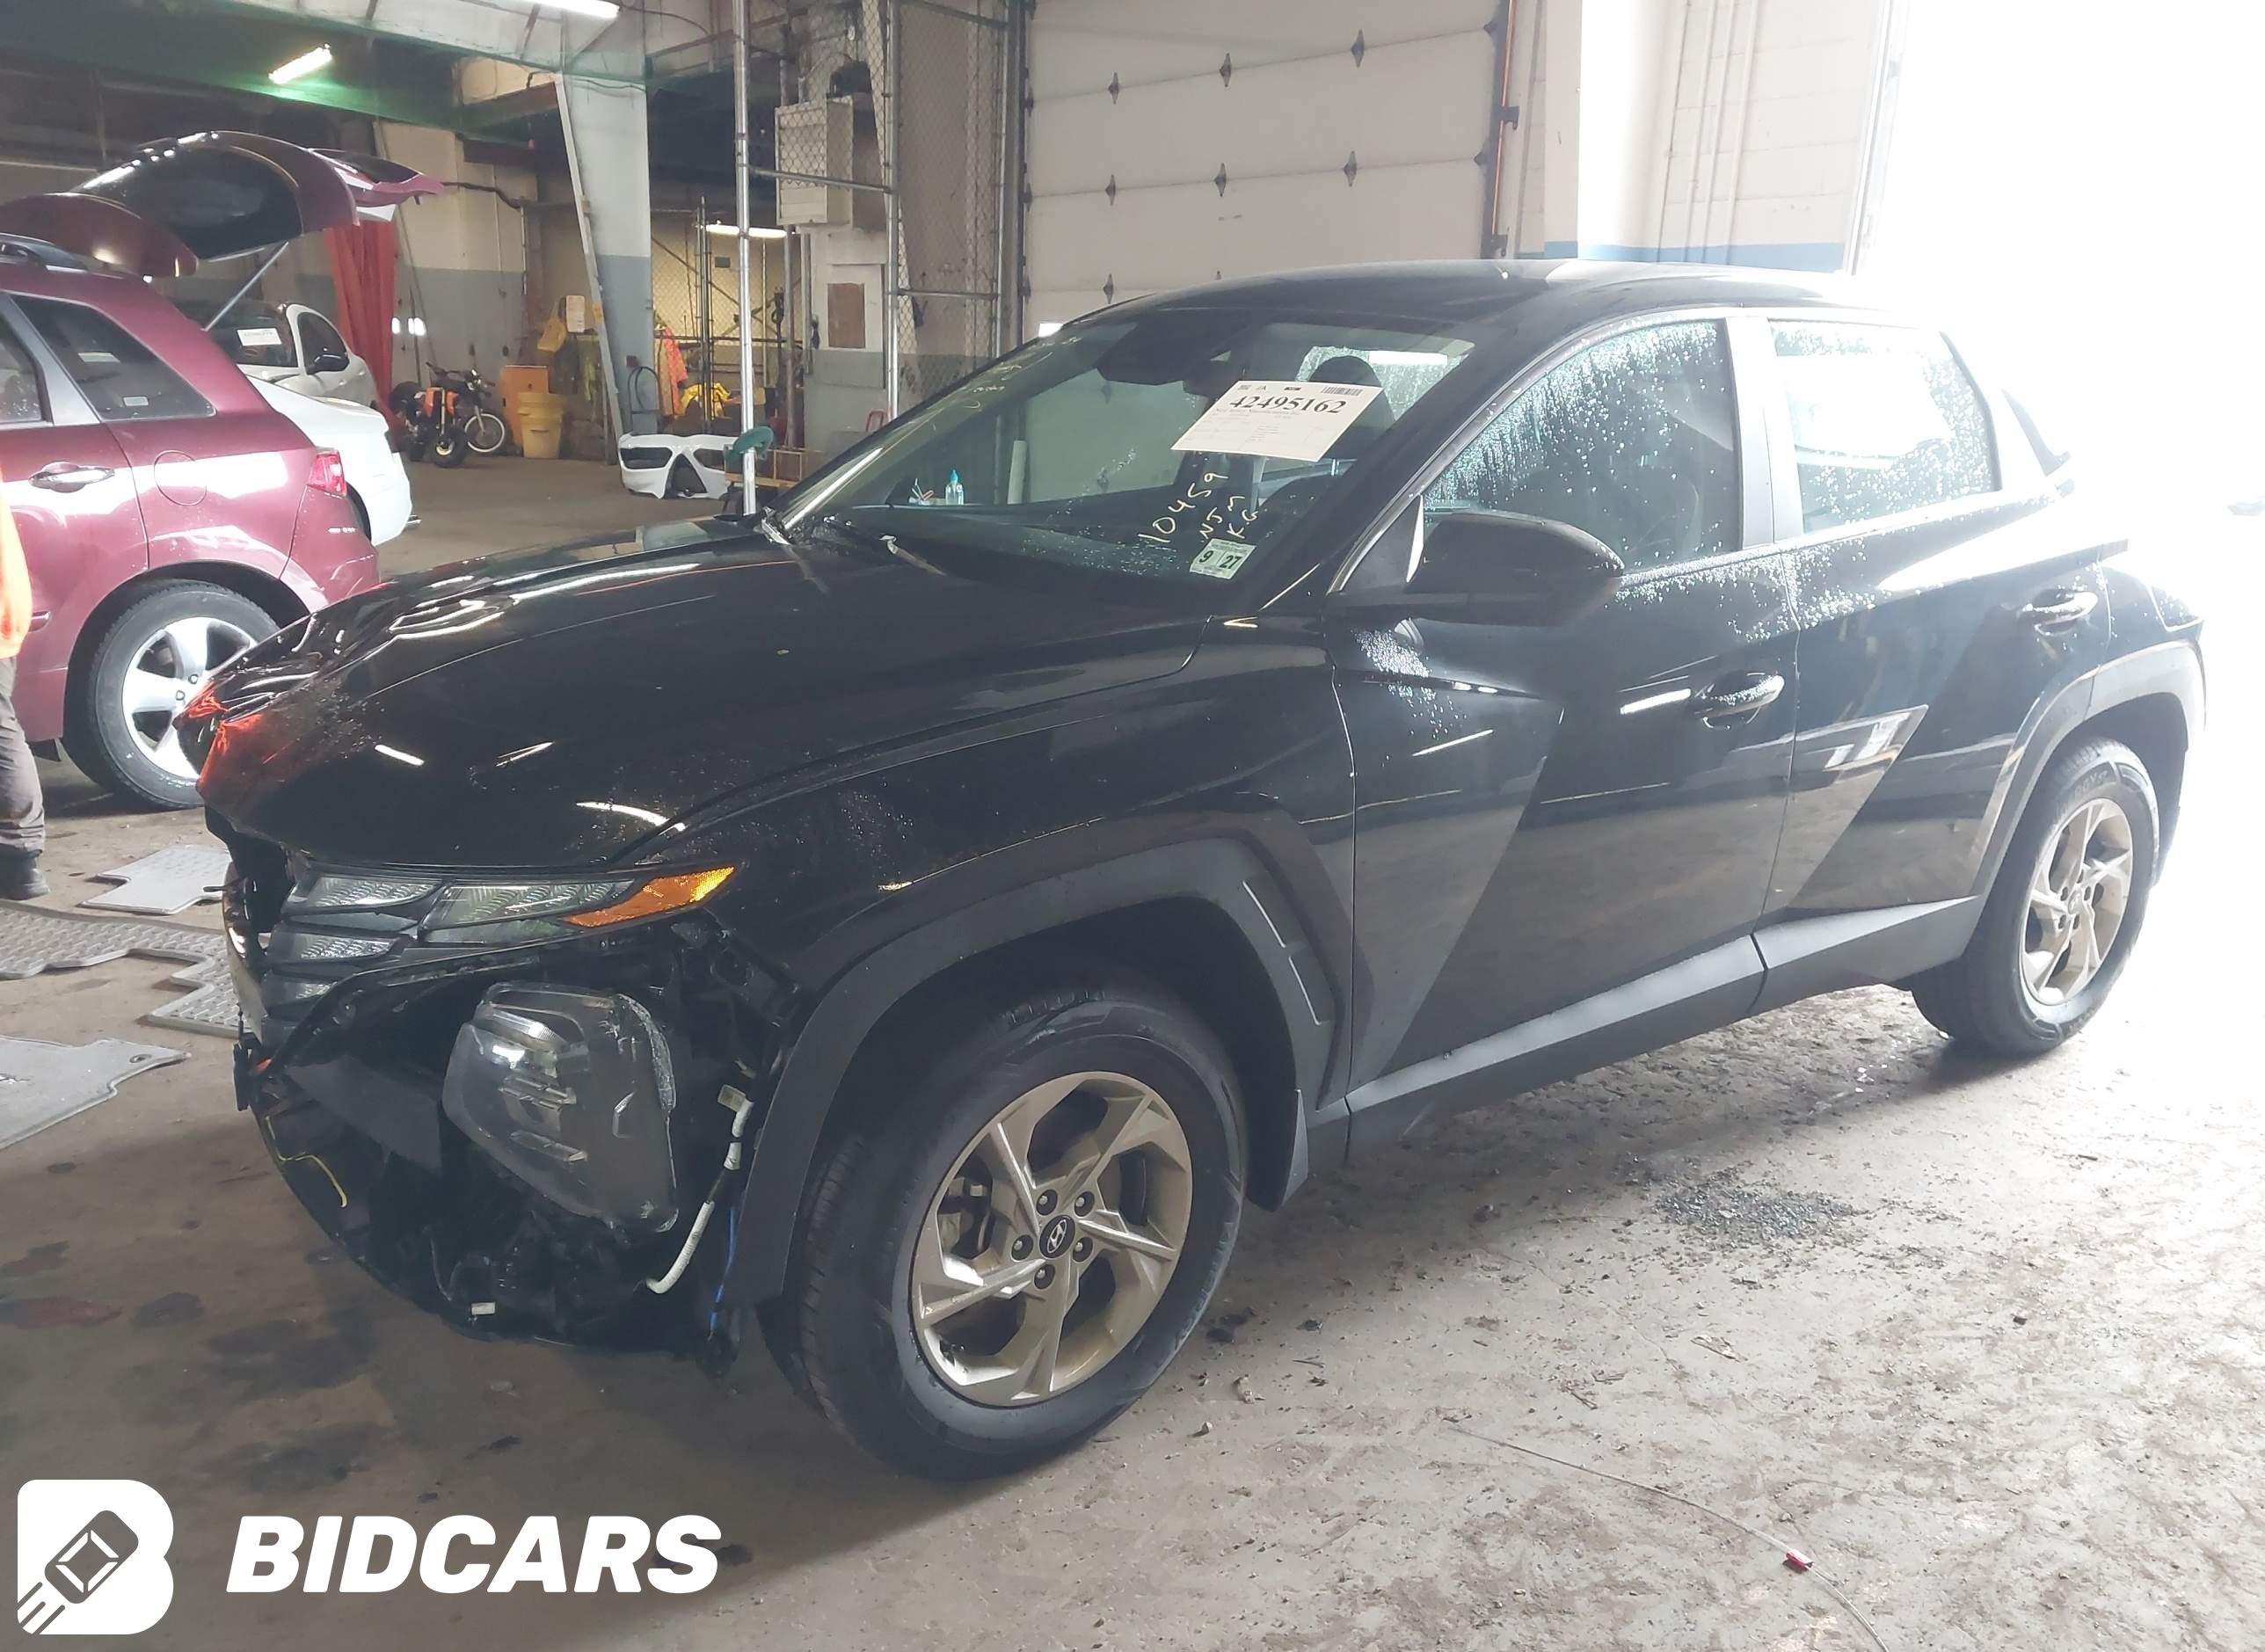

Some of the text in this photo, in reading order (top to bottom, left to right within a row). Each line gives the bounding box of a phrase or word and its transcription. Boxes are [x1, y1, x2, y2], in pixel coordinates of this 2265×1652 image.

[1230, 396, 1346, 414] 42495162
[1138, 472, 1228, 542] 10459
[1199, 550, 1242, 570] 9 27
